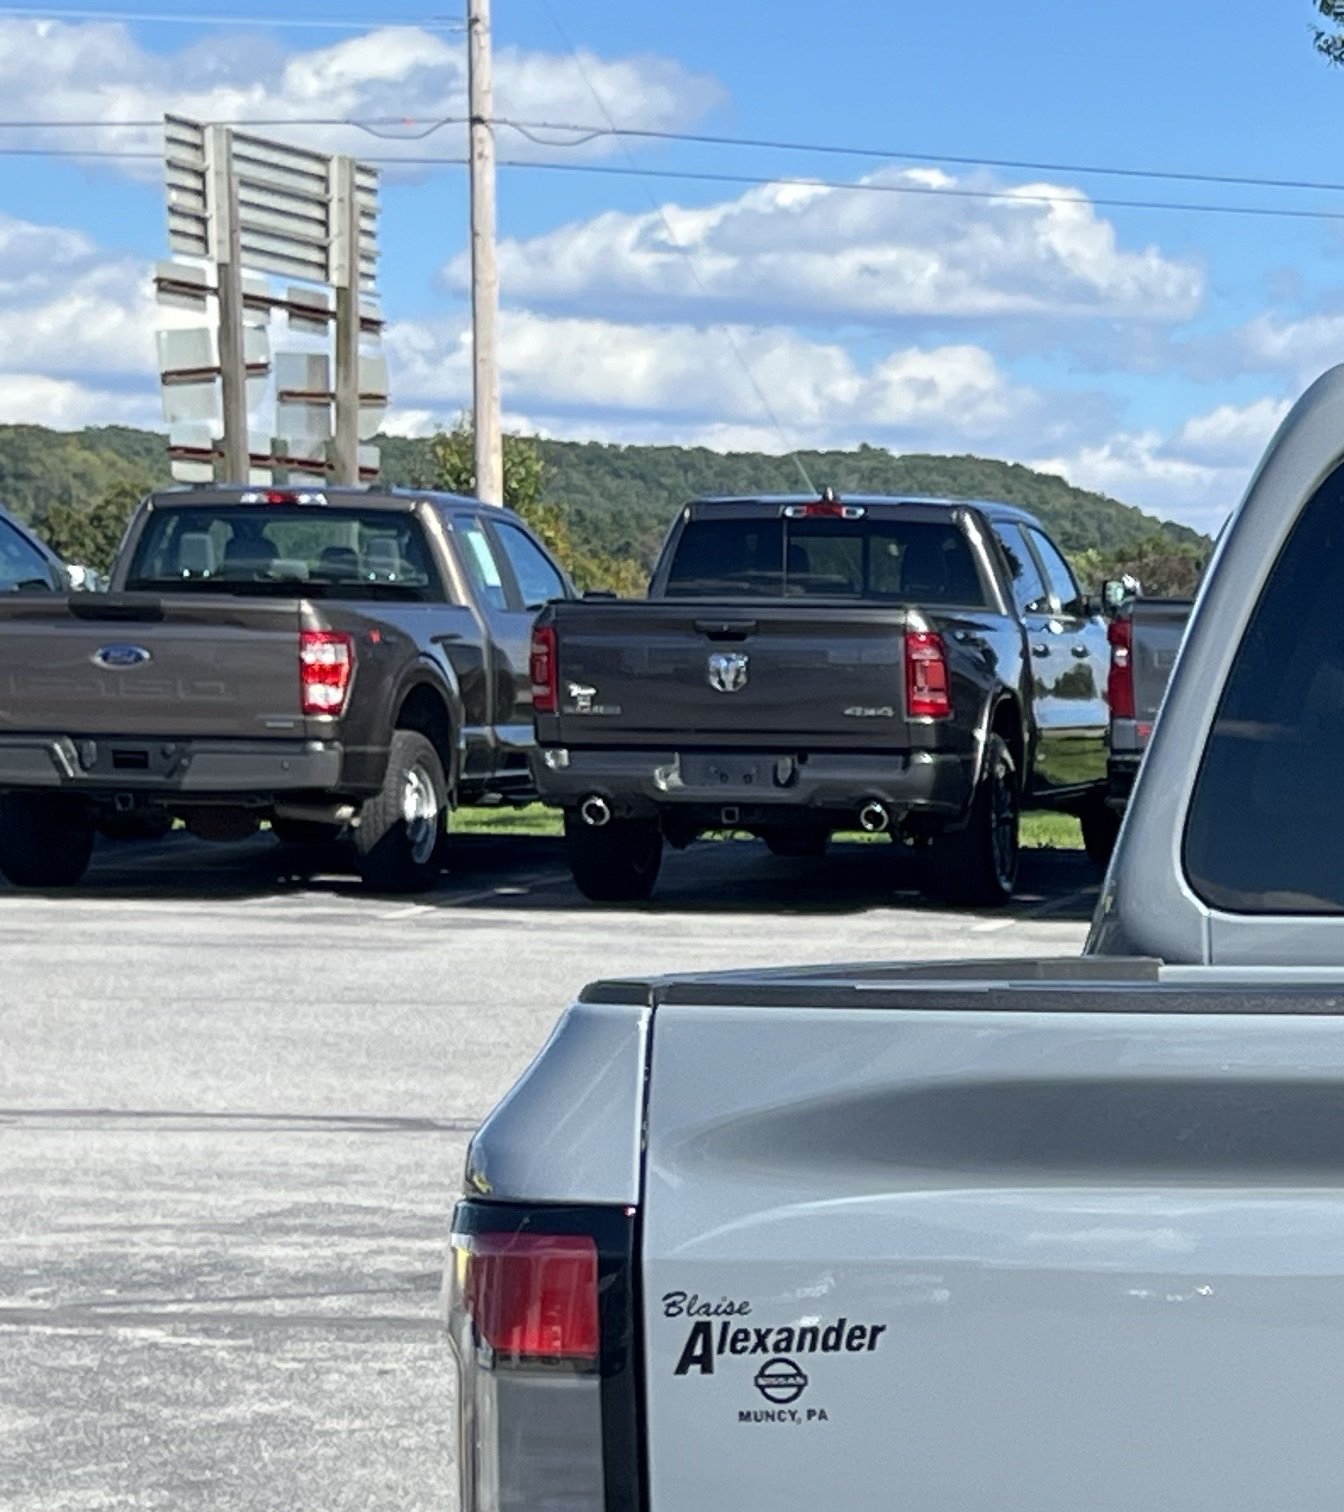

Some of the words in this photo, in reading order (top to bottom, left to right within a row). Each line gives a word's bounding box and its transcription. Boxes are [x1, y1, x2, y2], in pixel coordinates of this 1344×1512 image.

[661, 1290, 752, 1317] Blaise
[673, 1318, 887, 1375] Alexander
[738, 1408, 802, 1425] MUNCY,
[806, 1408, 829, 1421] PA
